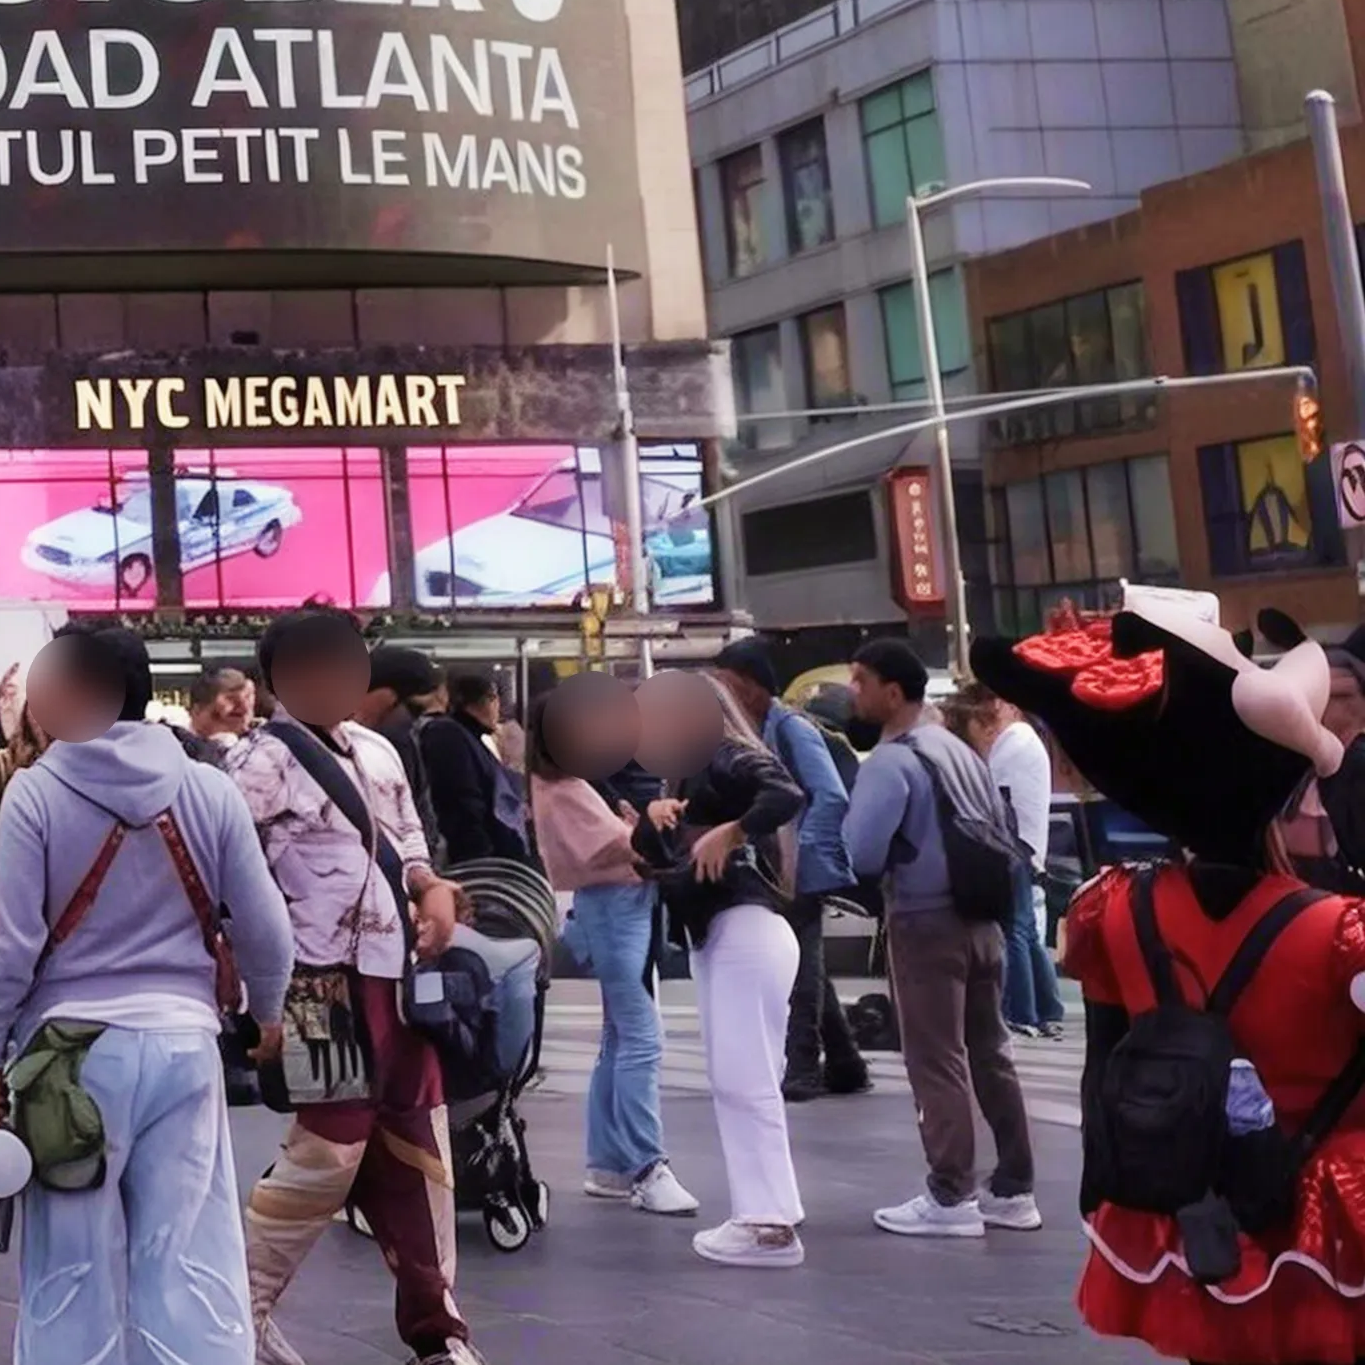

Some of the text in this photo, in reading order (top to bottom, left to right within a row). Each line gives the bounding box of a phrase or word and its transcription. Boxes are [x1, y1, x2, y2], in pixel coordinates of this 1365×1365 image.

[191, 27, 580, 130] ATLANTA
[134, 130, 319, 185] PETIT
[339, 131, 408, 187] LE
[424, 133, 586, 200] MANS
[75, 374, 466, 430] NYC MEGAMART
